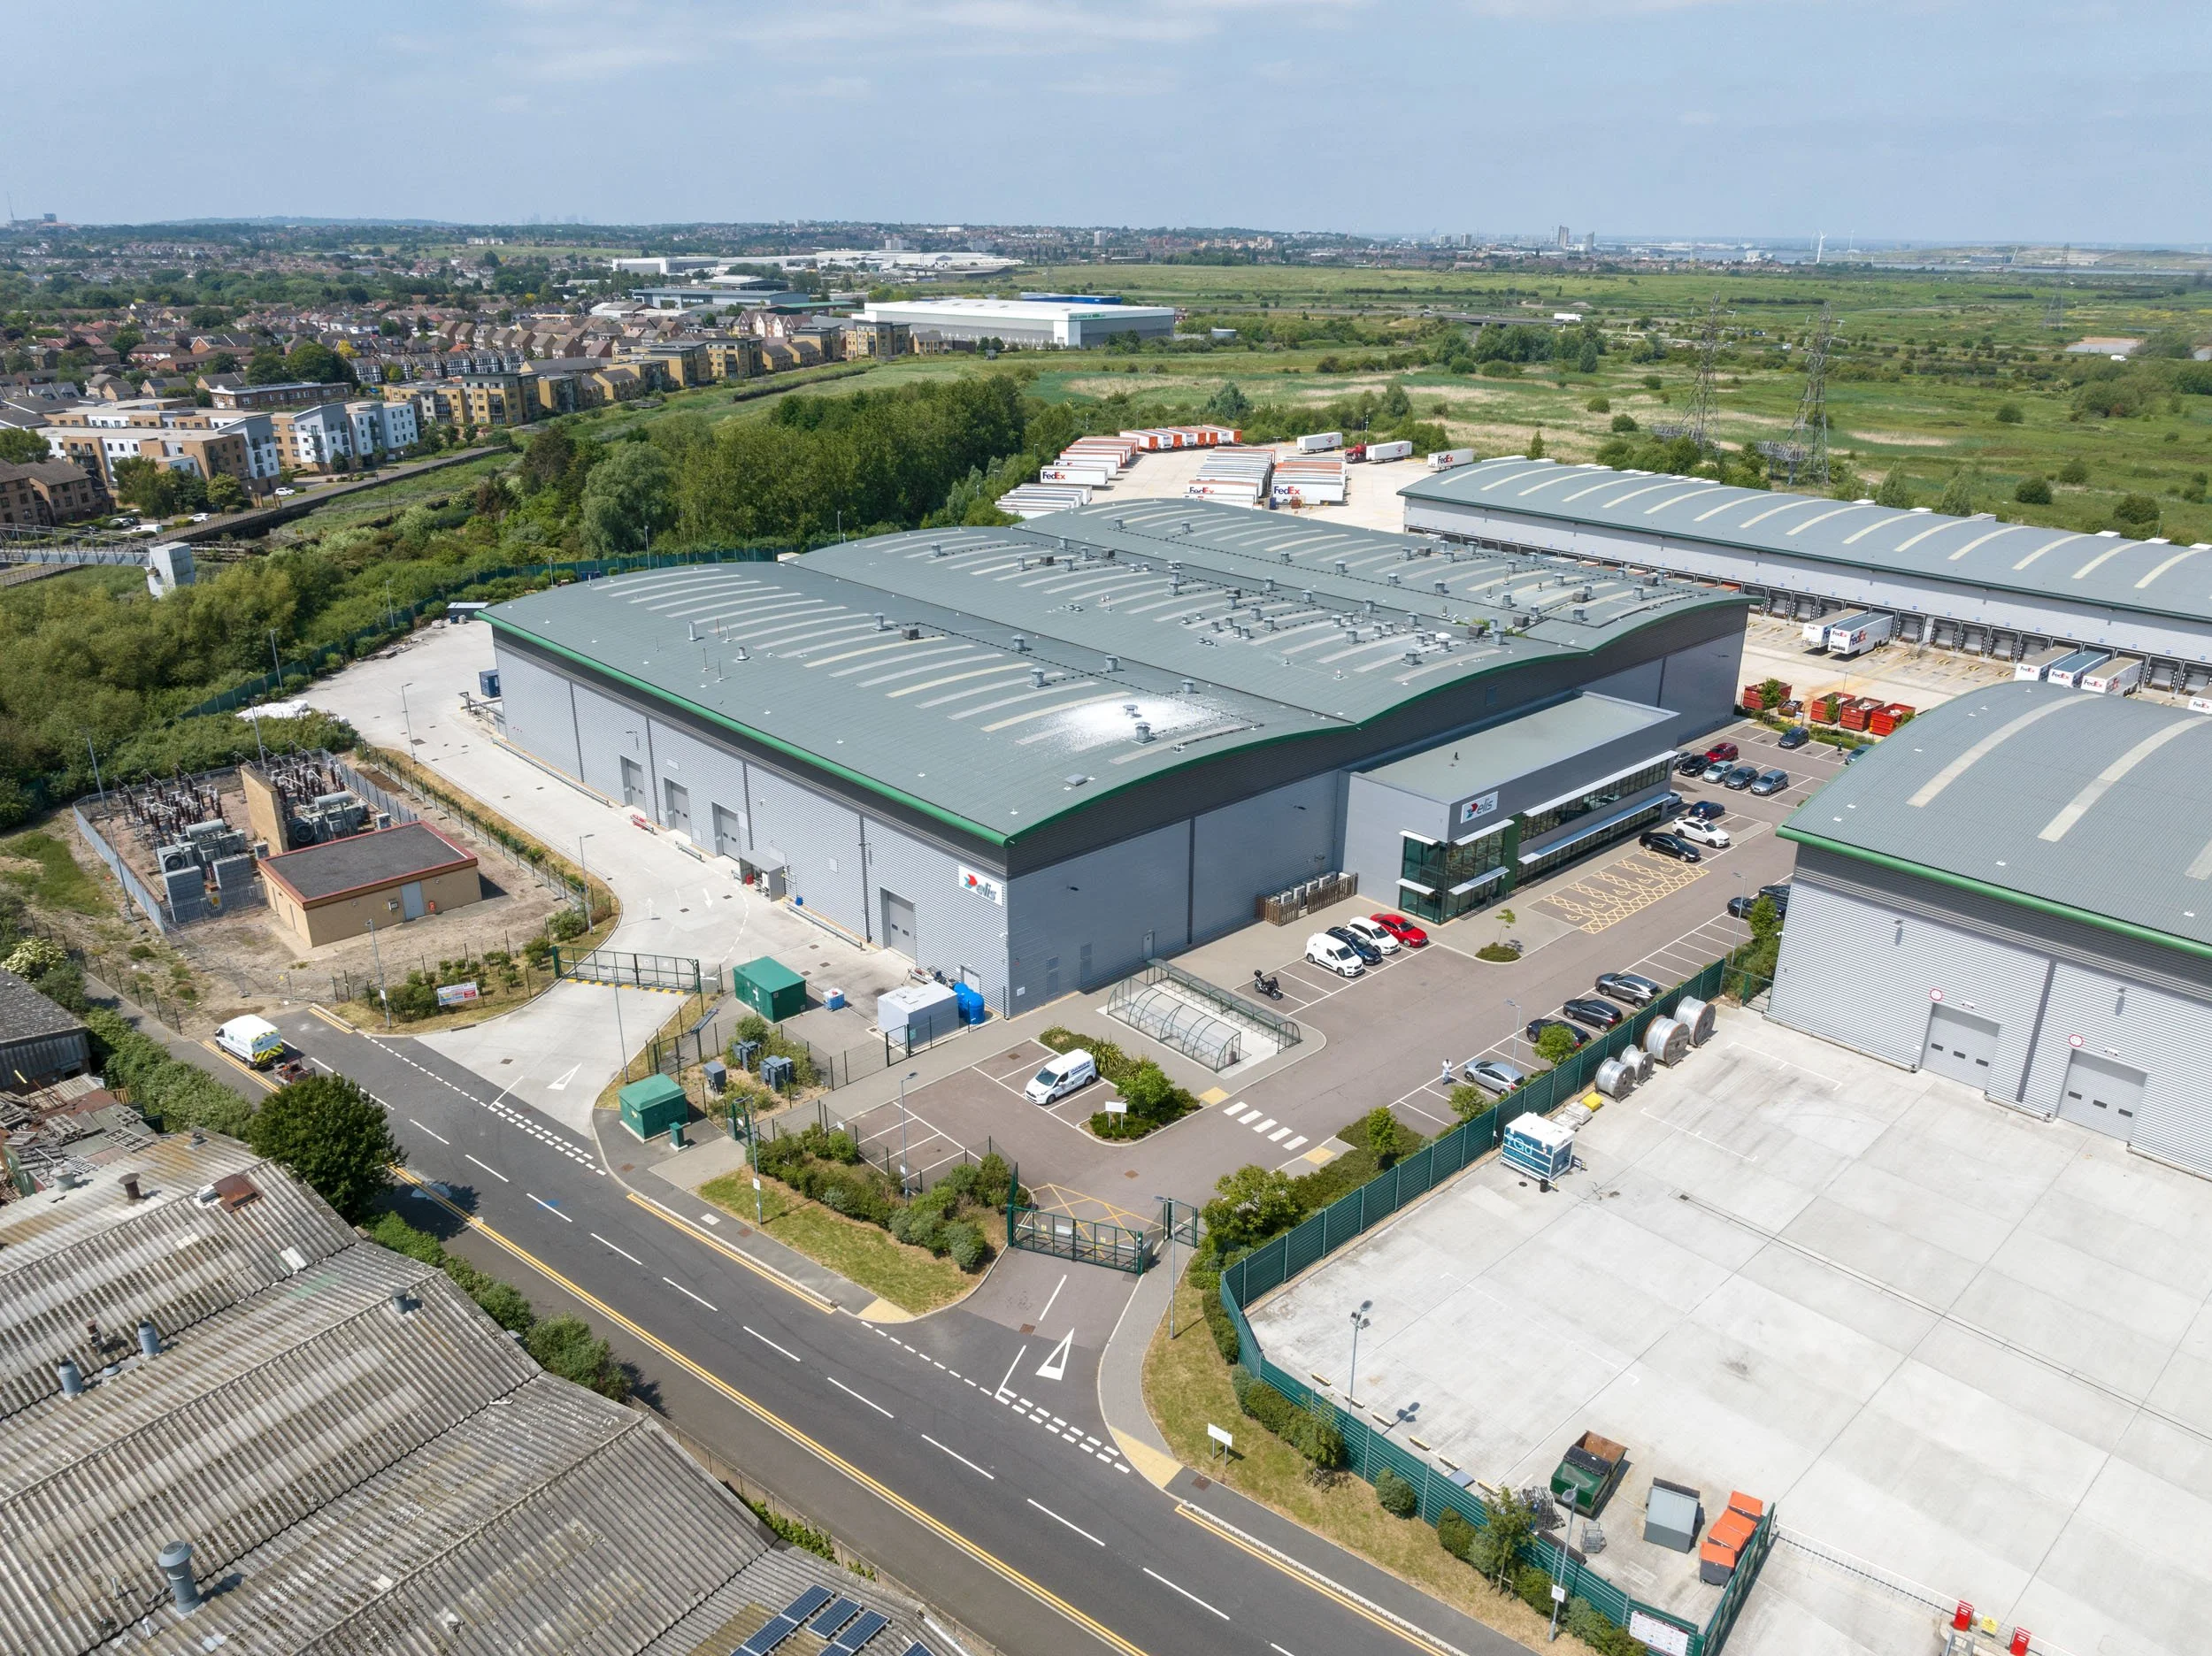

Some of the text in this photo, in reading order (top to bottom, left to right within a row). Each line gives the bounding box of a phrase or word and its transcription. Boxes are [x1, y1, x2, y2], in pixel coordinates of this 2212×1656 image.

[1438, 454, 1453, 464] FedEx
[1042, 472, 1065, 480] FedEx
[1273, 487, 1300, 495] FedEx
[1849, 630, 1867, 647] FedEx
[2052, 671, 2070, 680] FedEx
[2193, 701, 2210, 709] FedEx
[1477, 798, 1493, 814] elis
[976, 882, 996, 901] elis
